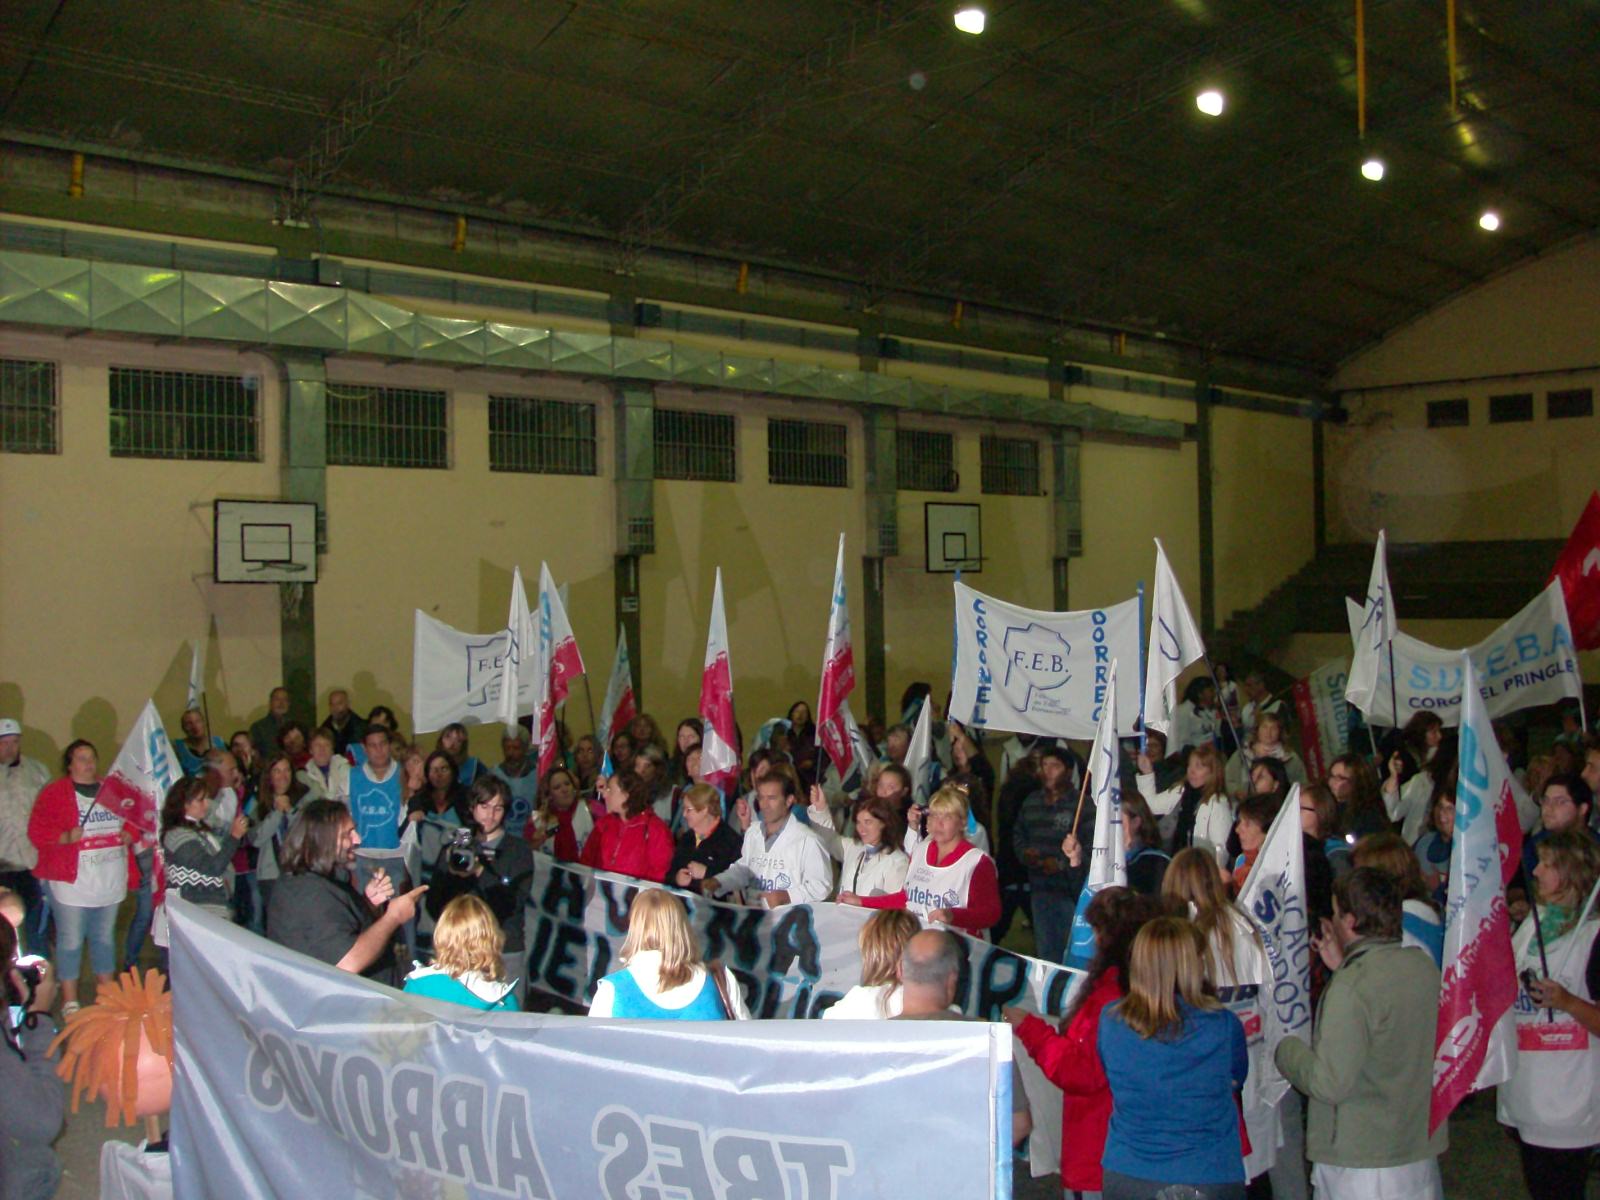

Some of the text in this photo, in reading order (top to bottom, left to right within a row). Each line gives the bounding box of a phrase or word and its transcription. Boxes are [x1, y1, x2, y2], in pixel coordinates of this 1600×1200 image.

[971, 598, 993, 724] CORONEL
[1013, 650, 1069, 673] F.E.B.
[1091, 610, 1109, 722] DORRE
[1408, 685, 1499, 710] COROEL
[906, 881, 942, 910] uteba
